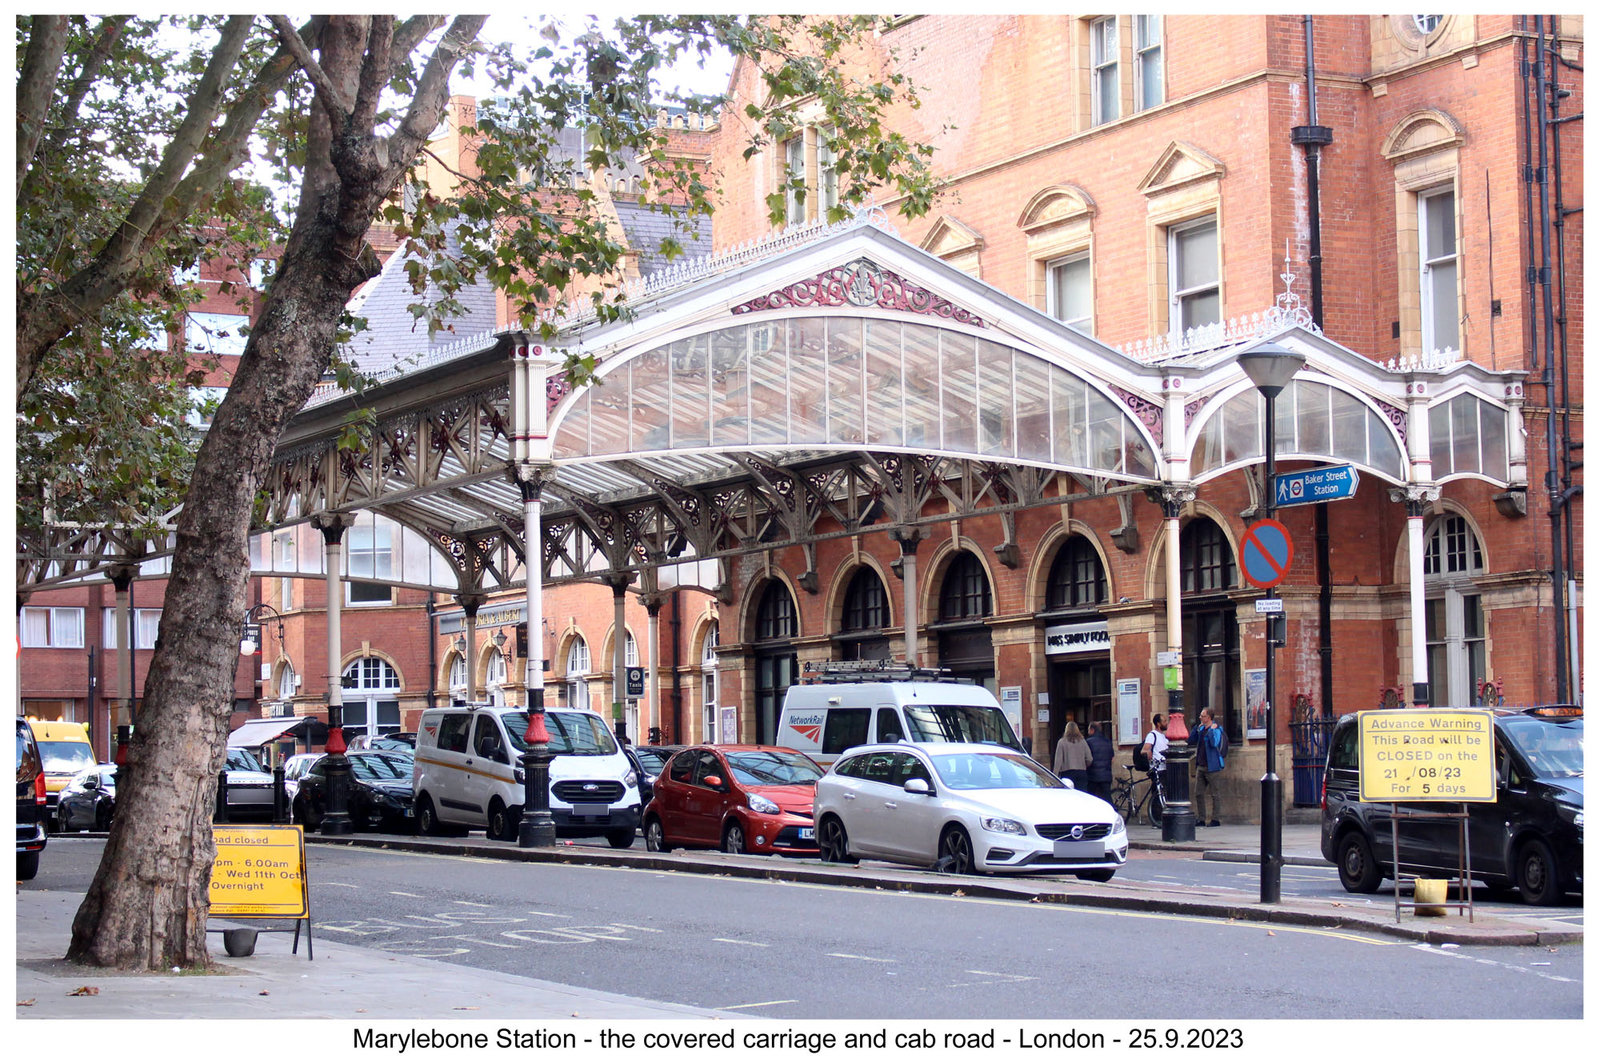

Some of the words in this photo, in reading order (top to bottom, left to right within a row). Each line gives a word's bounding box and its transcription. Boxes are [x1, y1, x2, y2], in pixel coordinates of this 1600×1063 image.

[1304, 475, 1324, 485] Baker
[1325, 470, 1348, 482] Street
[1314, 484, 1339, 495] Station
[1064, 631, 1090, 645] SIMPLY
[1090, 630, 1110, 642] FOO
[1371, 719, 1425, 729] Advance
[1430, 718, 1481, 730] Warning
[1372, 735, 1398, 745] This
[1403, 735, 1434, 745] Road
[1439, 735, 1462, 745] will
[1466, 735, 1481, 745] be
[1377, 751, 1433, 761] CLOSED
[1437, 752, 1453, 761] on
[1457, 751, 1478, 761] the
[1384, 768, 1398, 779] 21
[1391, 783, 1411, 793] For
[1422, 783, 1431, 794] 5
[1437, 783, 1466, 794] days
[213, 835, 231, 844] oad
[234, 836, 269, 844] closed
[212, 859, 233, 867] pm
[245, 859, 289, 868] 6.00am
[226, 870, 251, 878] Wed
[254, 870, 276, 879] 11th
[280, 871, 301, 880] Oct
[211, 881, 265, 892] Overnight
